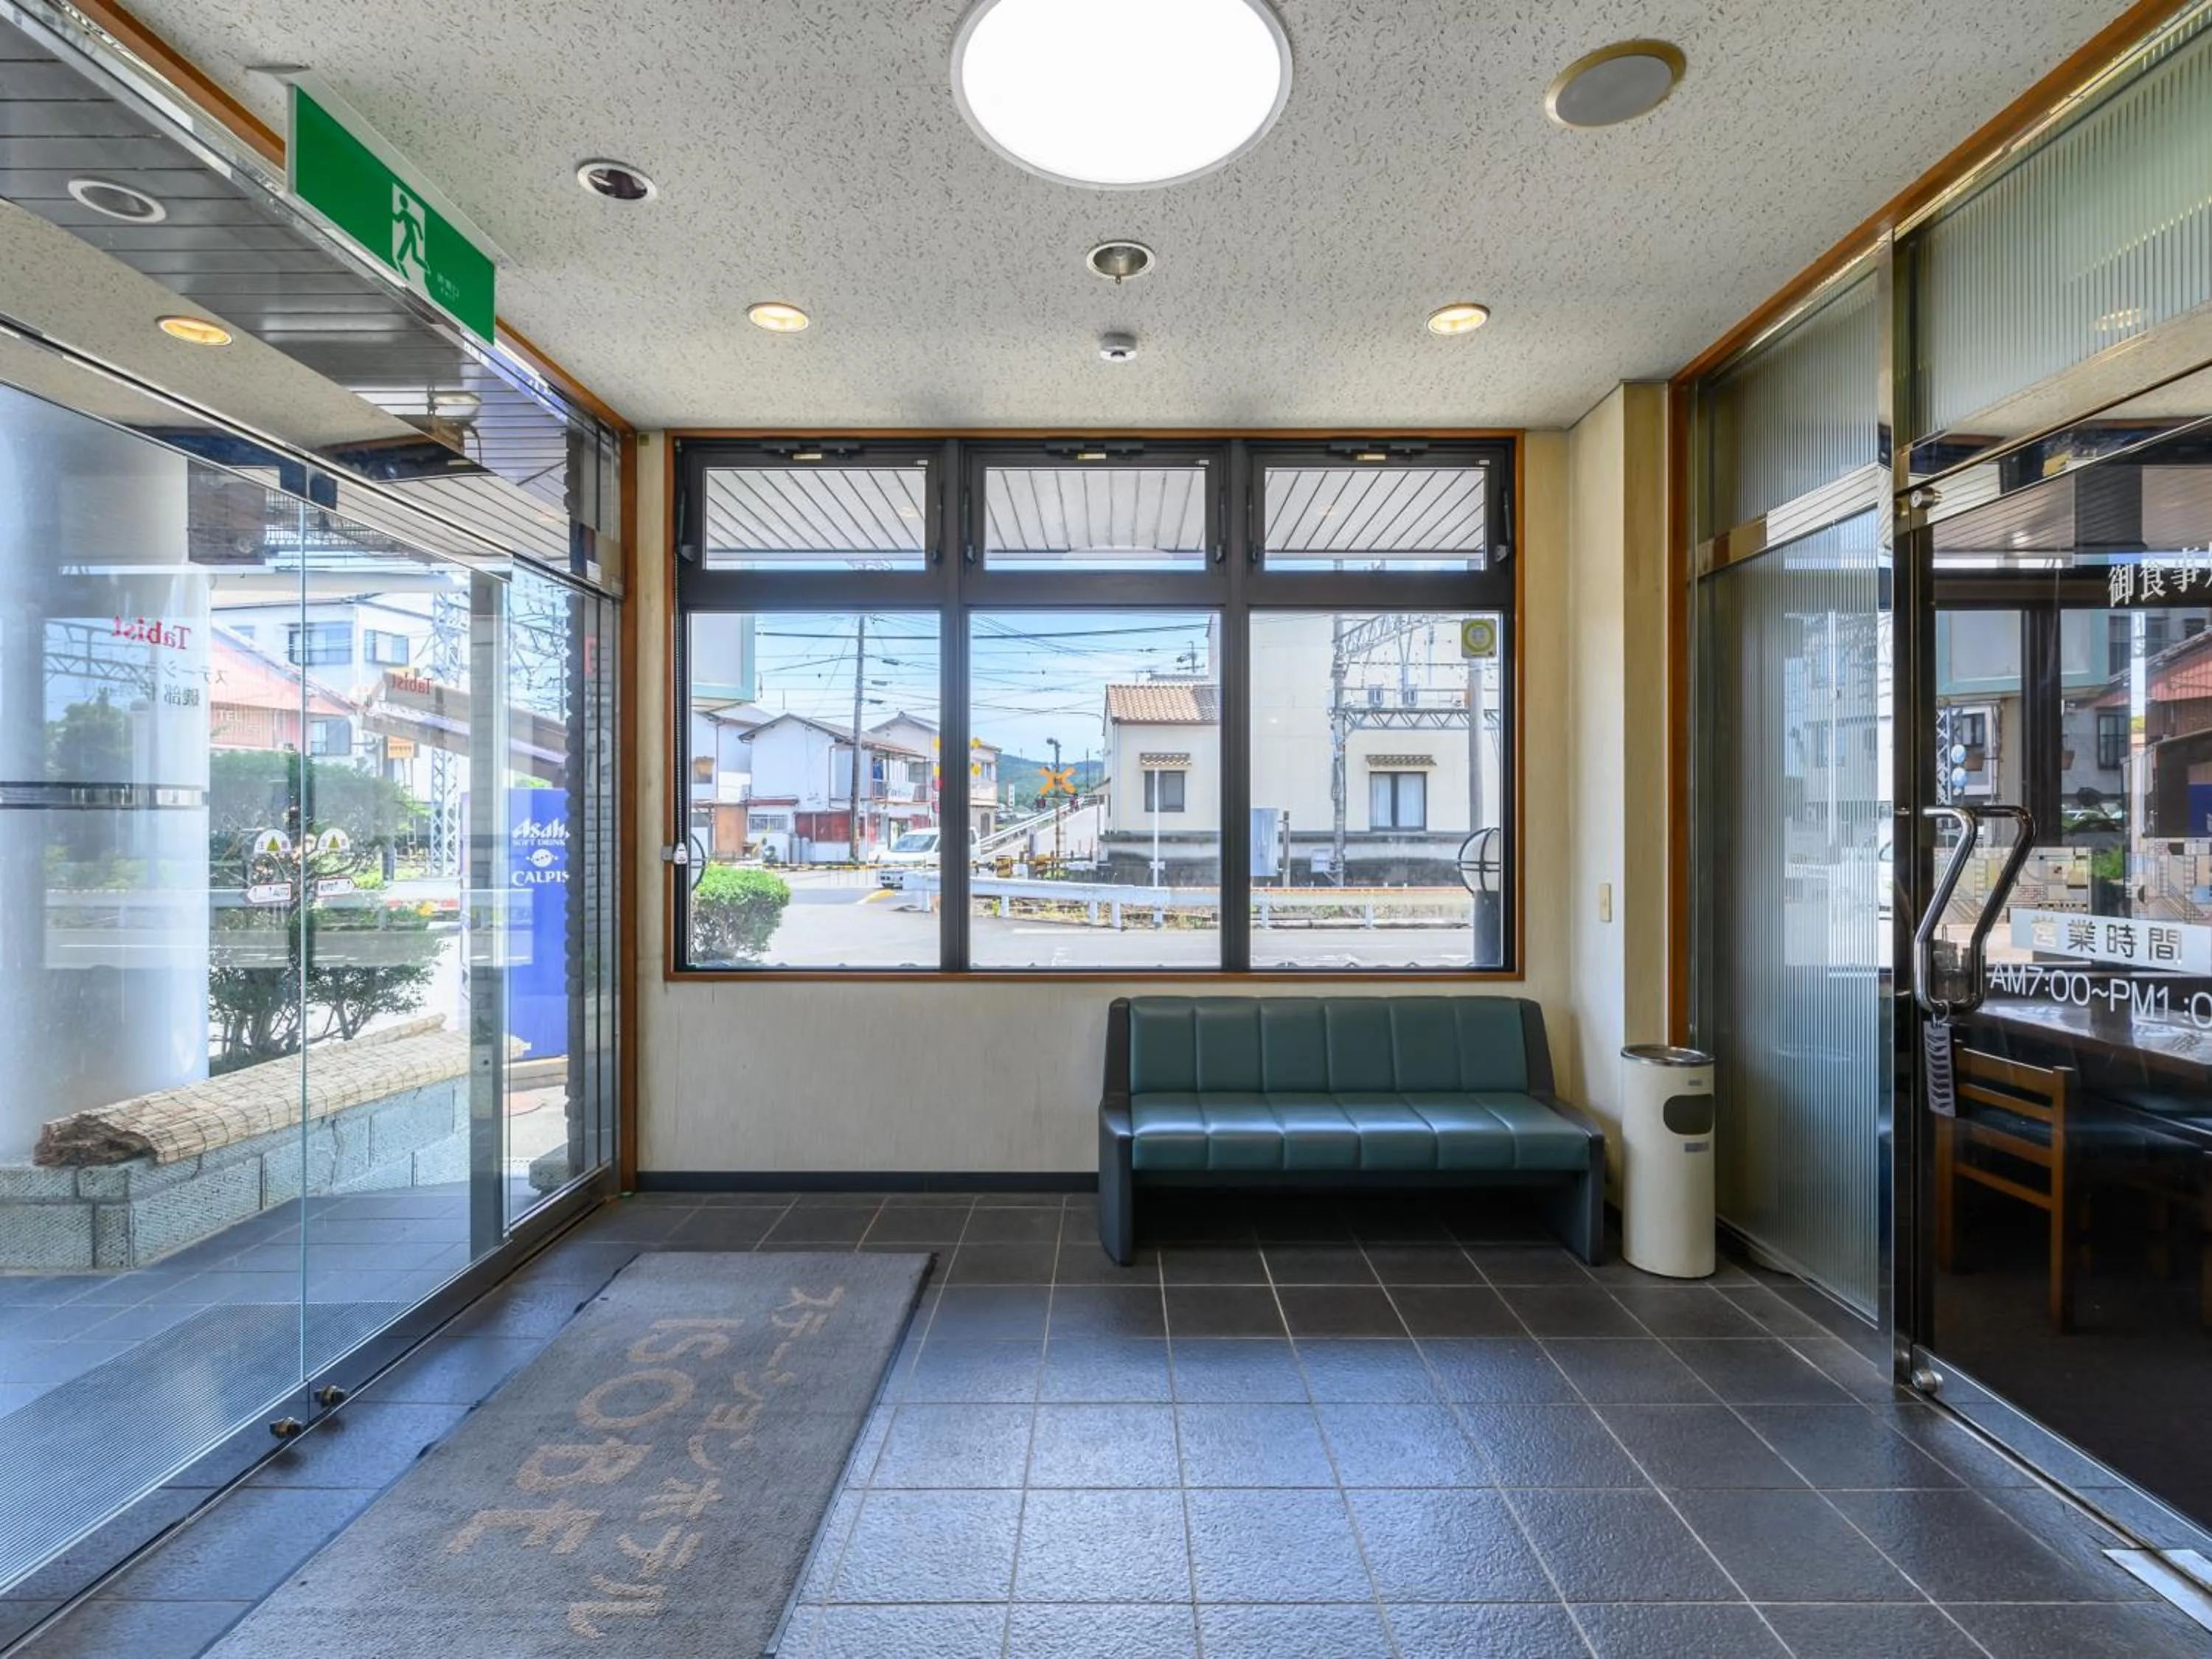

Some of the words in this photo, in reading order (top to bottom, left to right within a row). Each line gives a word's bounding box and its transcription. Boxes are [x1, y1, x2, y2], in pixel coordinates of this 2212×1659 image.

[2108, 542, 2212, 608] 御食事
[2031, 915, 2183, 965] 営業時間
[447, 1318, 745, 1556] ISOBE
